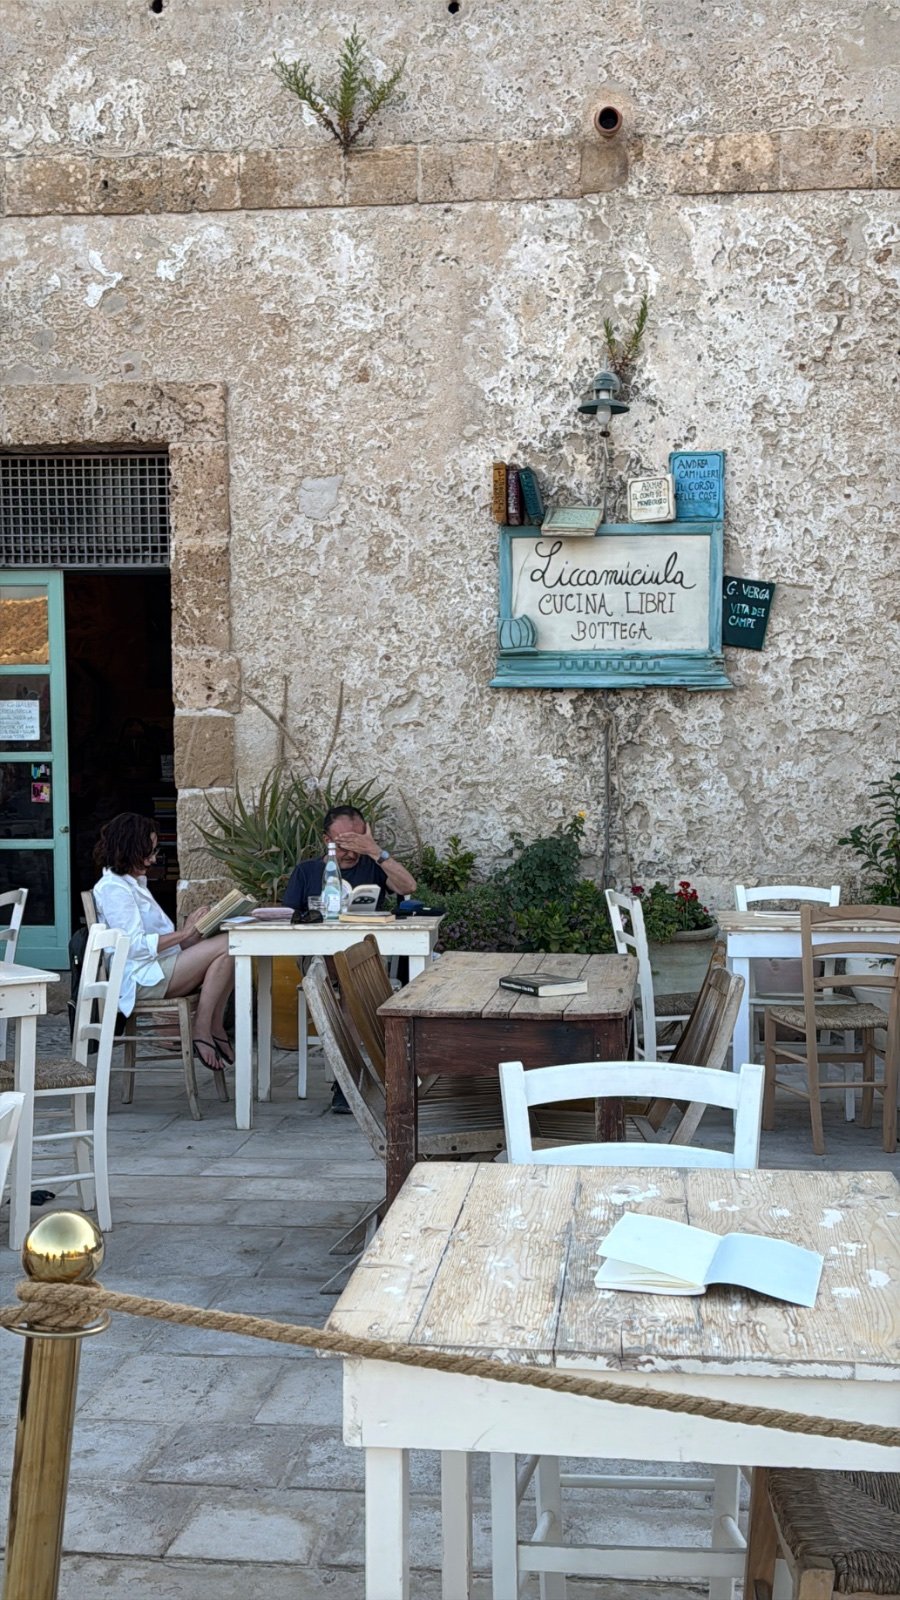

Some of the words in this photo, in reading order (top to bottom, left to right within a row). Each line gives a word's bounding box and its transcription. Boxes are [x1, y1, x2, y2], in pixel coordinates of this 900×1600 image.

[677, 459, 708, 470] ANDREA
[679, 470, 719, 479] CAMILLERI
[688, 480, 715, 491] CORSO
[698, 492, 717, 501] COSE
[726, 580, 739, 596] G.
[742, 583, 770, 600] VERGA
[538, 593, 613, 617] CUCINA
[624, 591, 677, 615] LIBRI
[730, 602, 750, 615] VITA
[750, 606, 766, 618] DEI
[728, 615, 756, 629] CAMPI
[571, 620, 653, 642] BOTTEGA
